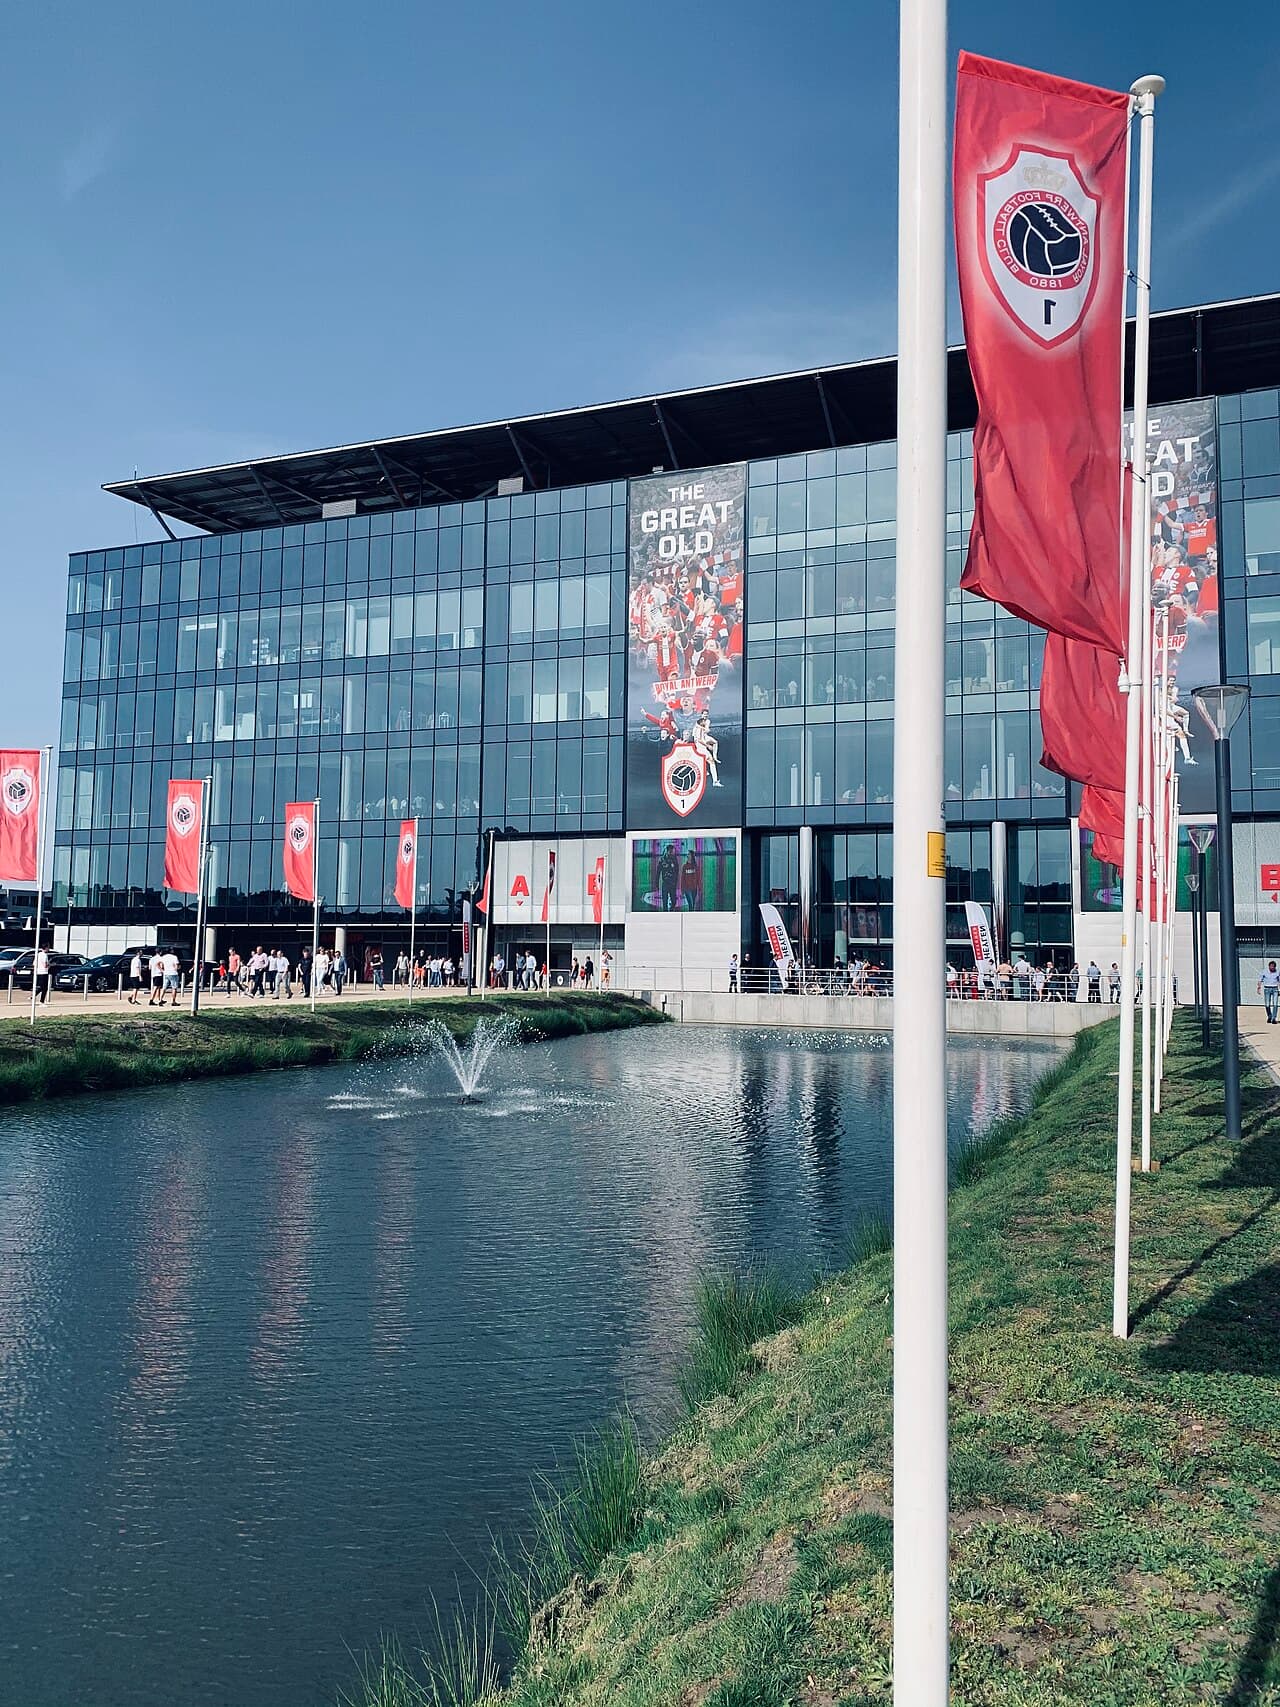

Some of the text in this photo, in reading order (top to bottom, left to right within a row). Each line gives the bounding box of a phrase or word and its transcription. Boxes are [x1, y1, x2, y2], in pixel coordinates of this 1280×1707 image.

[667, 483, 705, 502] THE
[641, 500, 734, 533] GREAT
[658, 531, 714, 558] OLD
[680, 675, 717, 689] ANTWERP
[510, 875, 530, 896] A
[1261, 863, 1280, 891] B
